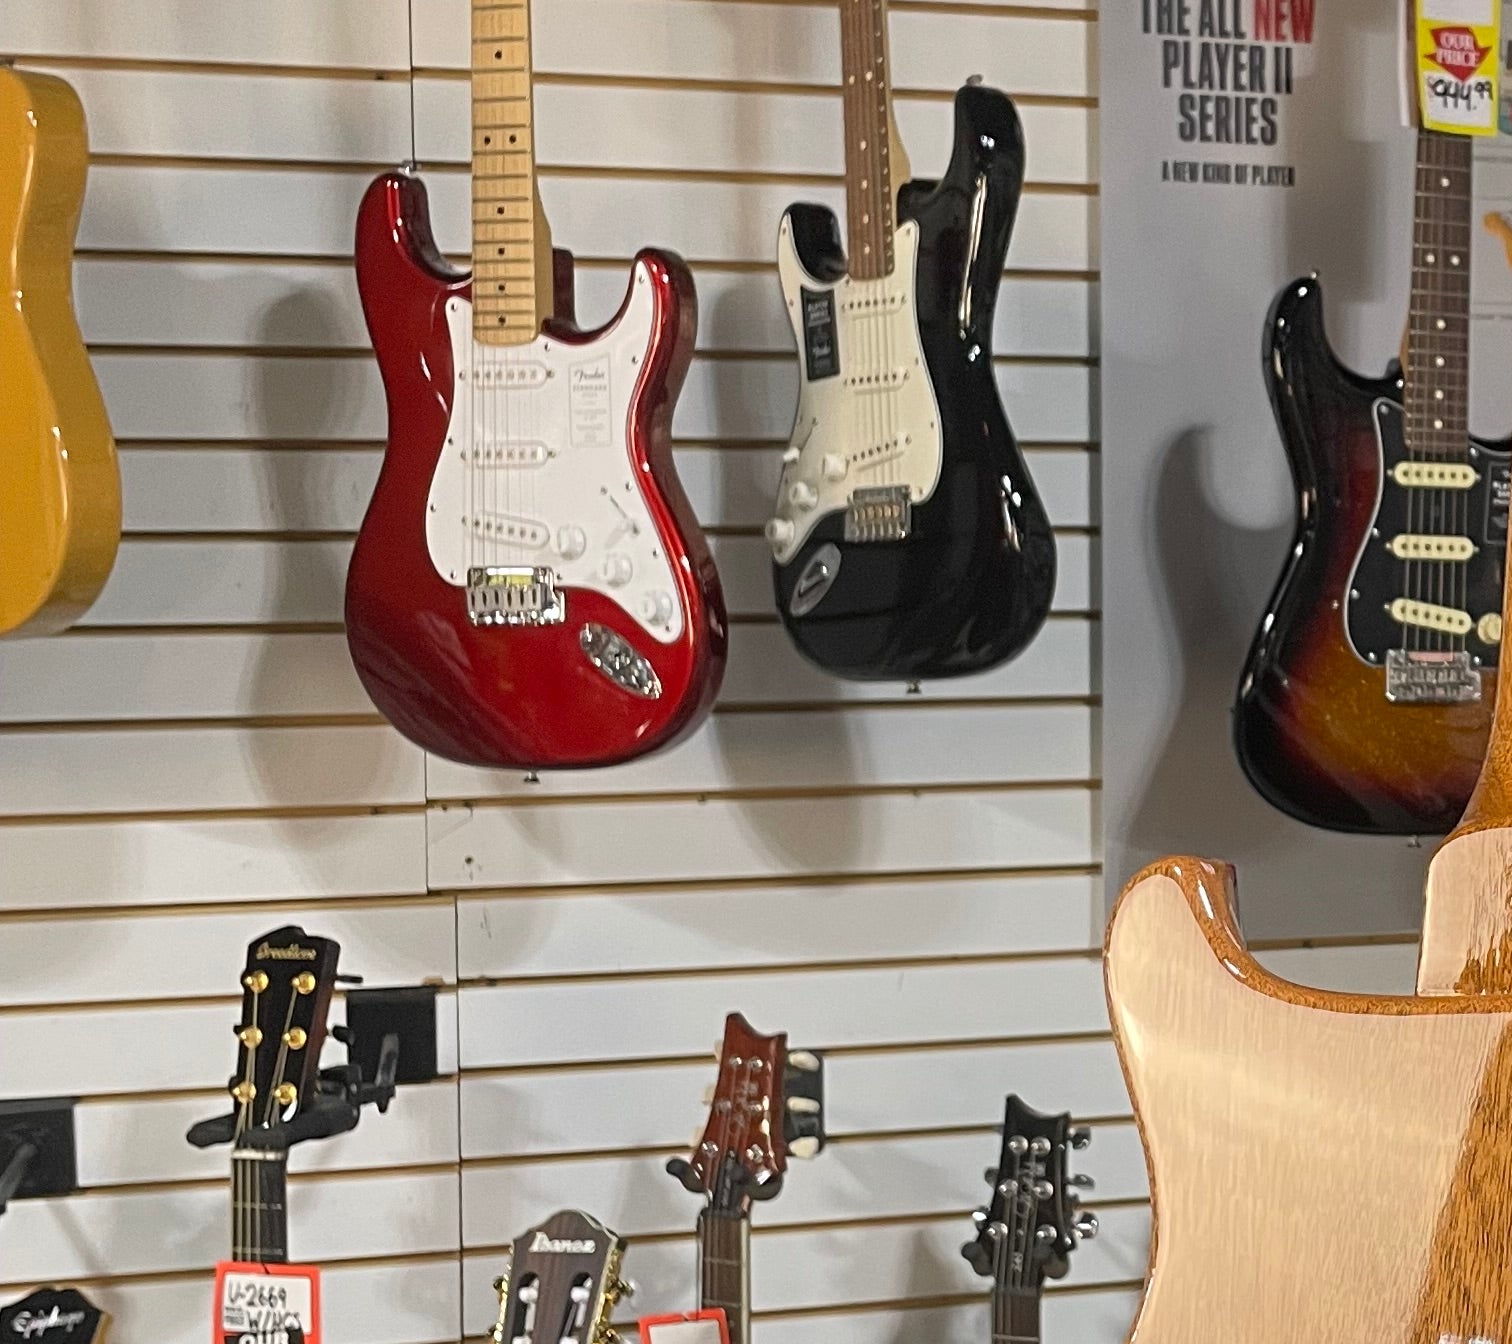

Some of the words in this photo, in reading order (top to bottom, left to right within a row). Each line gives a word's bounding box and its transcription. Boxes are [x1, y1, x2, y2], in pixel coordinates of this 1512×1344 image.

[1440, 32, 1475, 50] OUR
[1162, 40, 1266, 94] PLAYER
[1274, 46, 1293, 95] II
[1436, 48, 1480, 67] PRICE
[1178, 93, 1279, 146] SERIES
[1162, 161, 1171, 182] A
[1173, 161, 1199, 183] NEW
[1203, 163, 1232, 184] KIND
[1252, 164, 1295, 187] PLAYER
